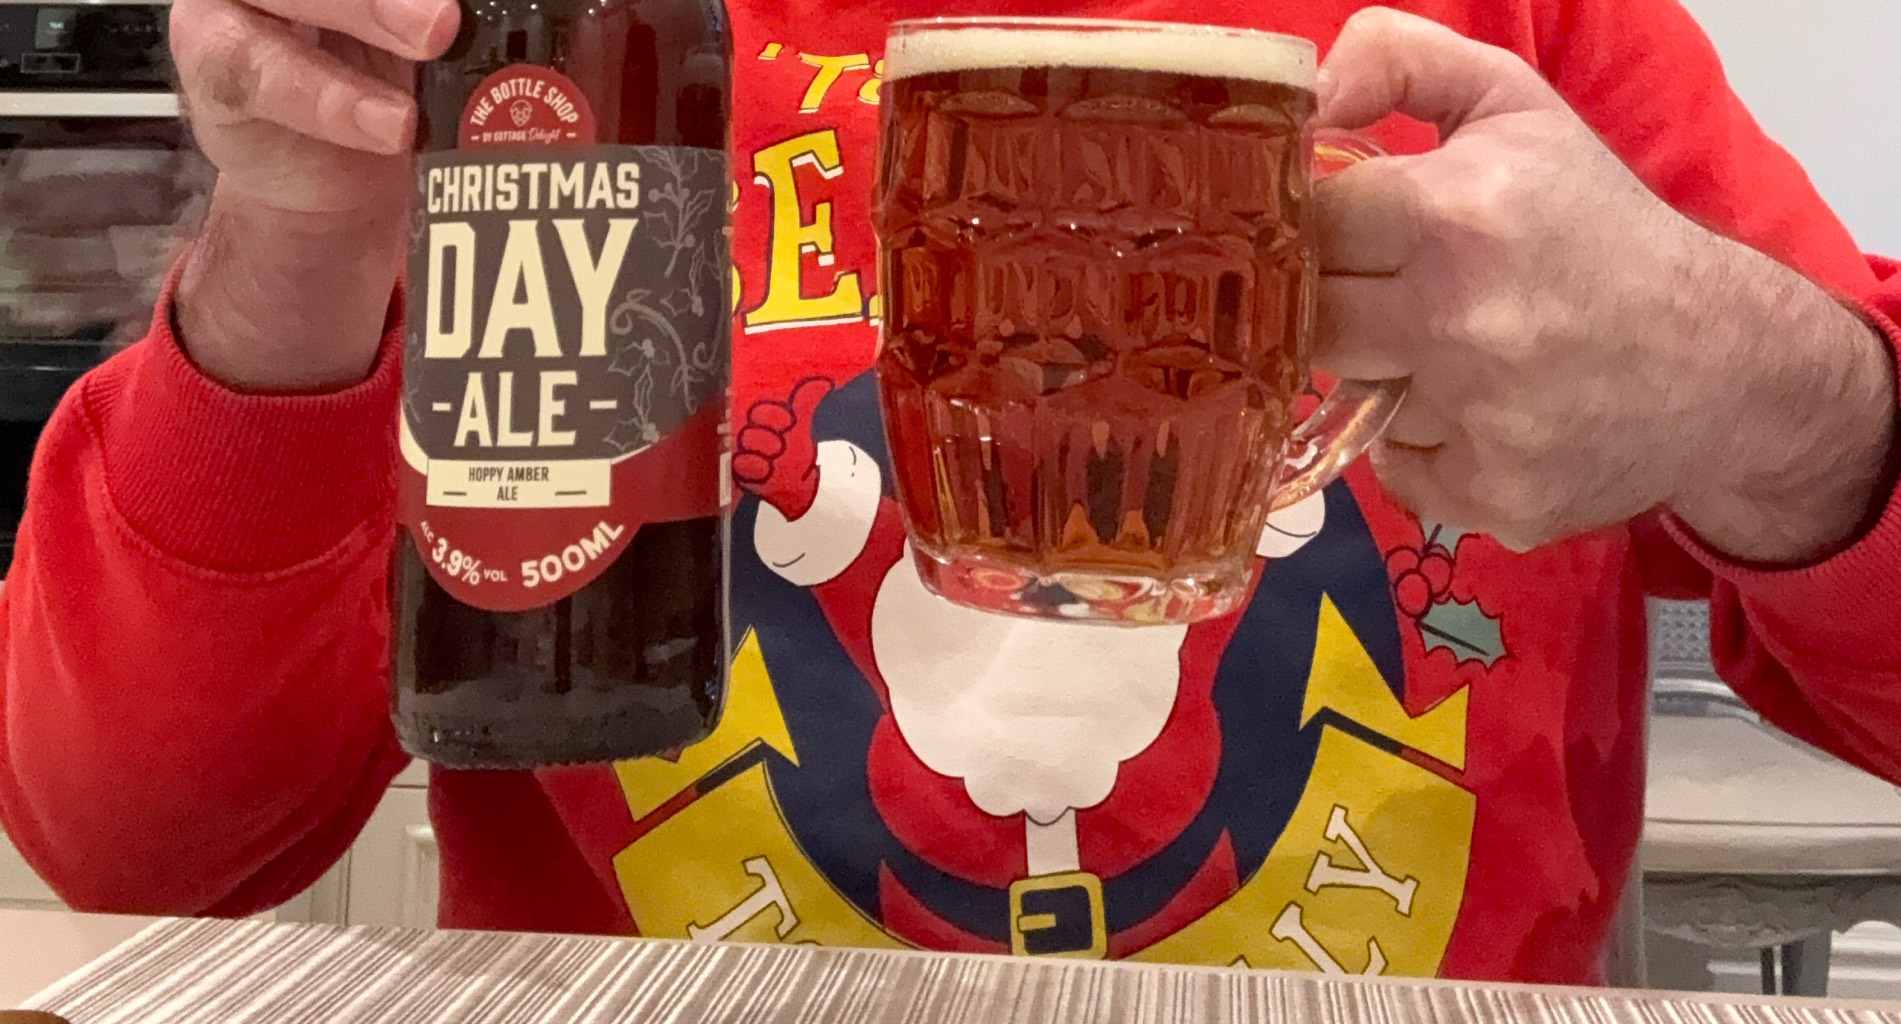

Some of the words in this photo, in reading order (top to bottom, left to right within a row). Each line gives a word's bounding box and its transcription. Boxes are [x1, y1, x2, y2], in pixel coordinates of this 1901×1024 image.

[470, 96, 494, 126] THE
[490, 77, 545, 105] BOTTLE
[543, 86, 579, 123] SHOP
[493, 130, 527, 142] COTTAGE
[427, 162, 640, 214] CHRISTMAS
[424, 218, 640, 359] DAY
[468, 466, 504, 482] HOPPY
[506, 466, 549, 482] AMBER
[496, 486, 518, 501] ALE
[421, 520, 434, 544] ALC
[432, 537, 482, 586] 3.9%
[484, 568, 508, 582] VOL
[521, 520, 625, 588] 500ML
